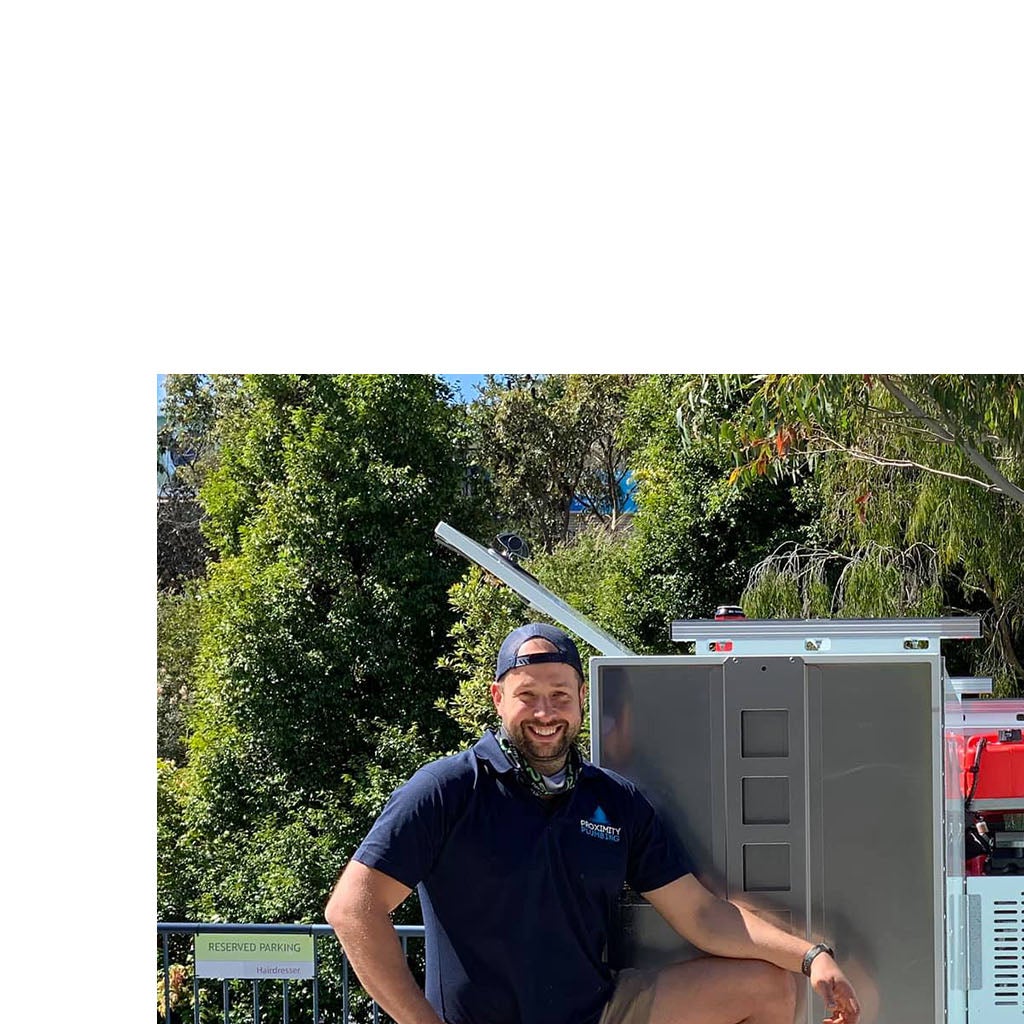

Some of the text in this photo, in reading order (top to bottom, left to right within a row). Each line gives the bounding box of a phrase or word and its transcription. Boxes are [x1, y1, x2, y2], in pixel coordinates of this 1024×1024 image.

[208, 942, 301, 953] RESERVED PARKING
[256, 966, 301, 975] Hairdresser
